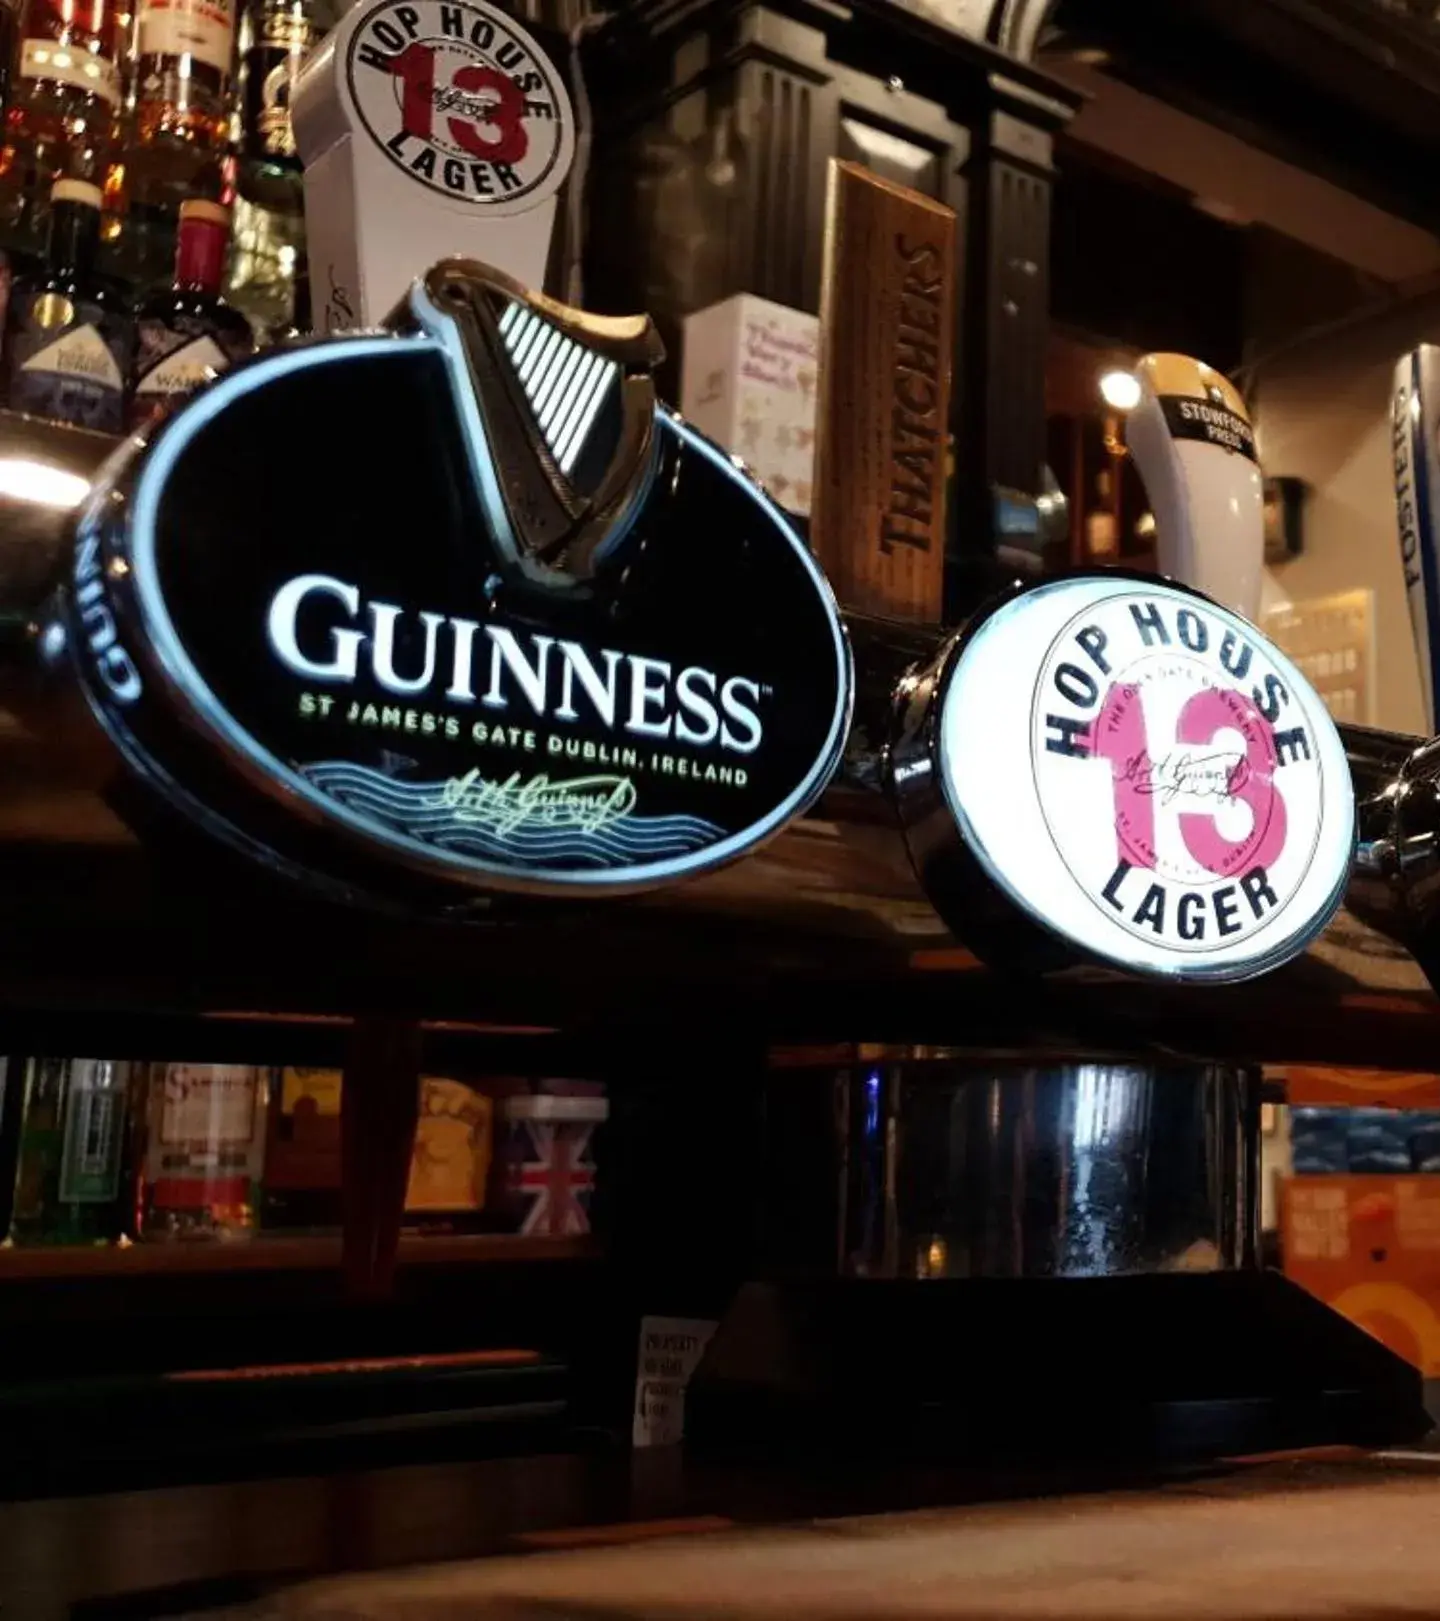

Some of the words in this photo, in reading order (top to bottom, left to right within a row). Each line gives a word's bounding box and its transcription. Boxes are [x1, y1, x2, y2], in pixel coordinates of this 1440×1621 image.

[358, 6, 419, 74] HOP
[440, 5, 552, 121] HOUSE
[386, 42, 528, 167] 13
[386, 129, 523, 194] LAGER
[877, 232, 943, 555] THATCHERS
[267, 573, 762, 755] GUINNESS
[1045, 624, 1112, 760] HOP
[1129, 603, 1311, 766] HOUSE
[300, 693, 335, 715] ST
[347, 700, 460, 737] JAMES'S
[472, 721, 537, 749] GATE
[652, 753, 748, 787] IRELAND
[1080, 680, 1288, 878] 13
[1101, 857, 1280, 940] LAGER
